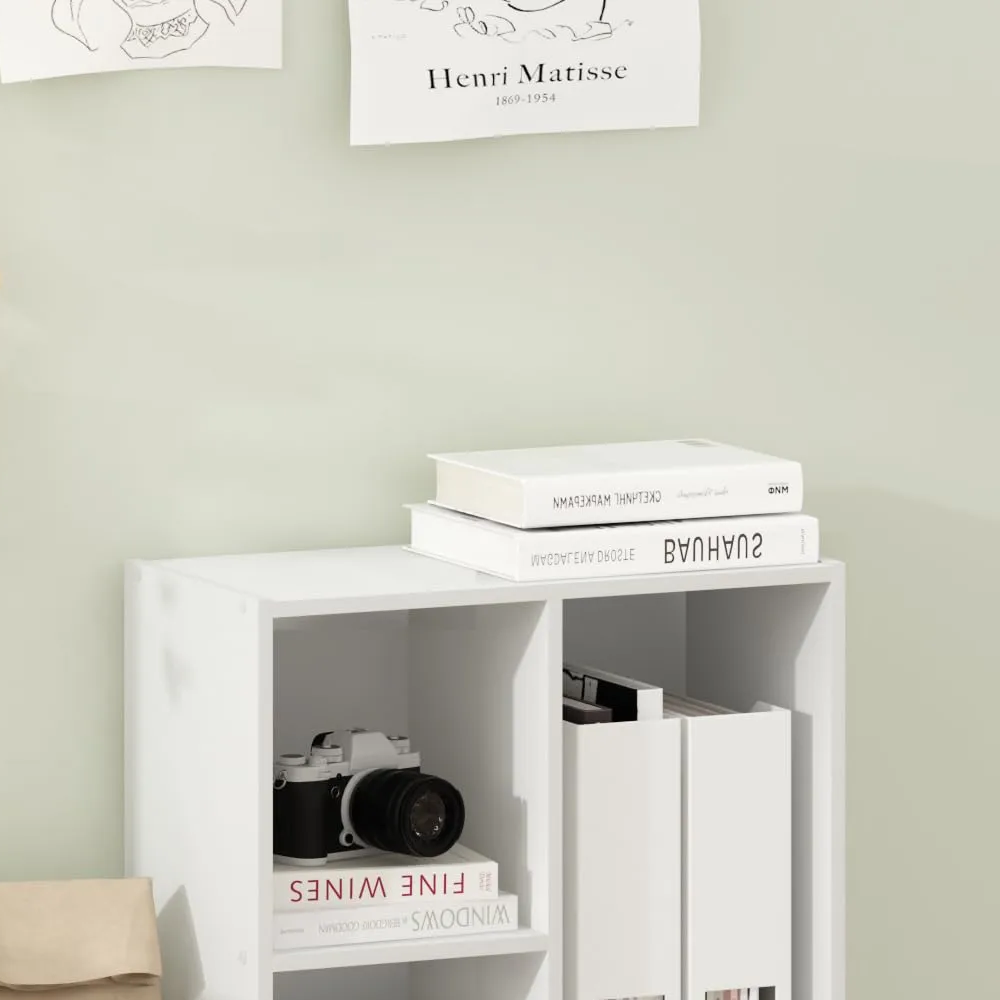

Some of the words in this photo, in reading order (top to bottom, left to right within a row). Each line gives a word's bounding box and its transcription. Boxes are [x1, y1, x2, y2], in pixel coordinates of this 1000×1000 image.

[427, 66, 508, 90] Henri
[518, 62, 628, 84] Matisse
[495, 93, 557, 106] 1869-1954
[290, 876, 387, 903] WINES
[401, 872, 465, 897] FINE
[411, 904, 511, 932] WINDOWS
